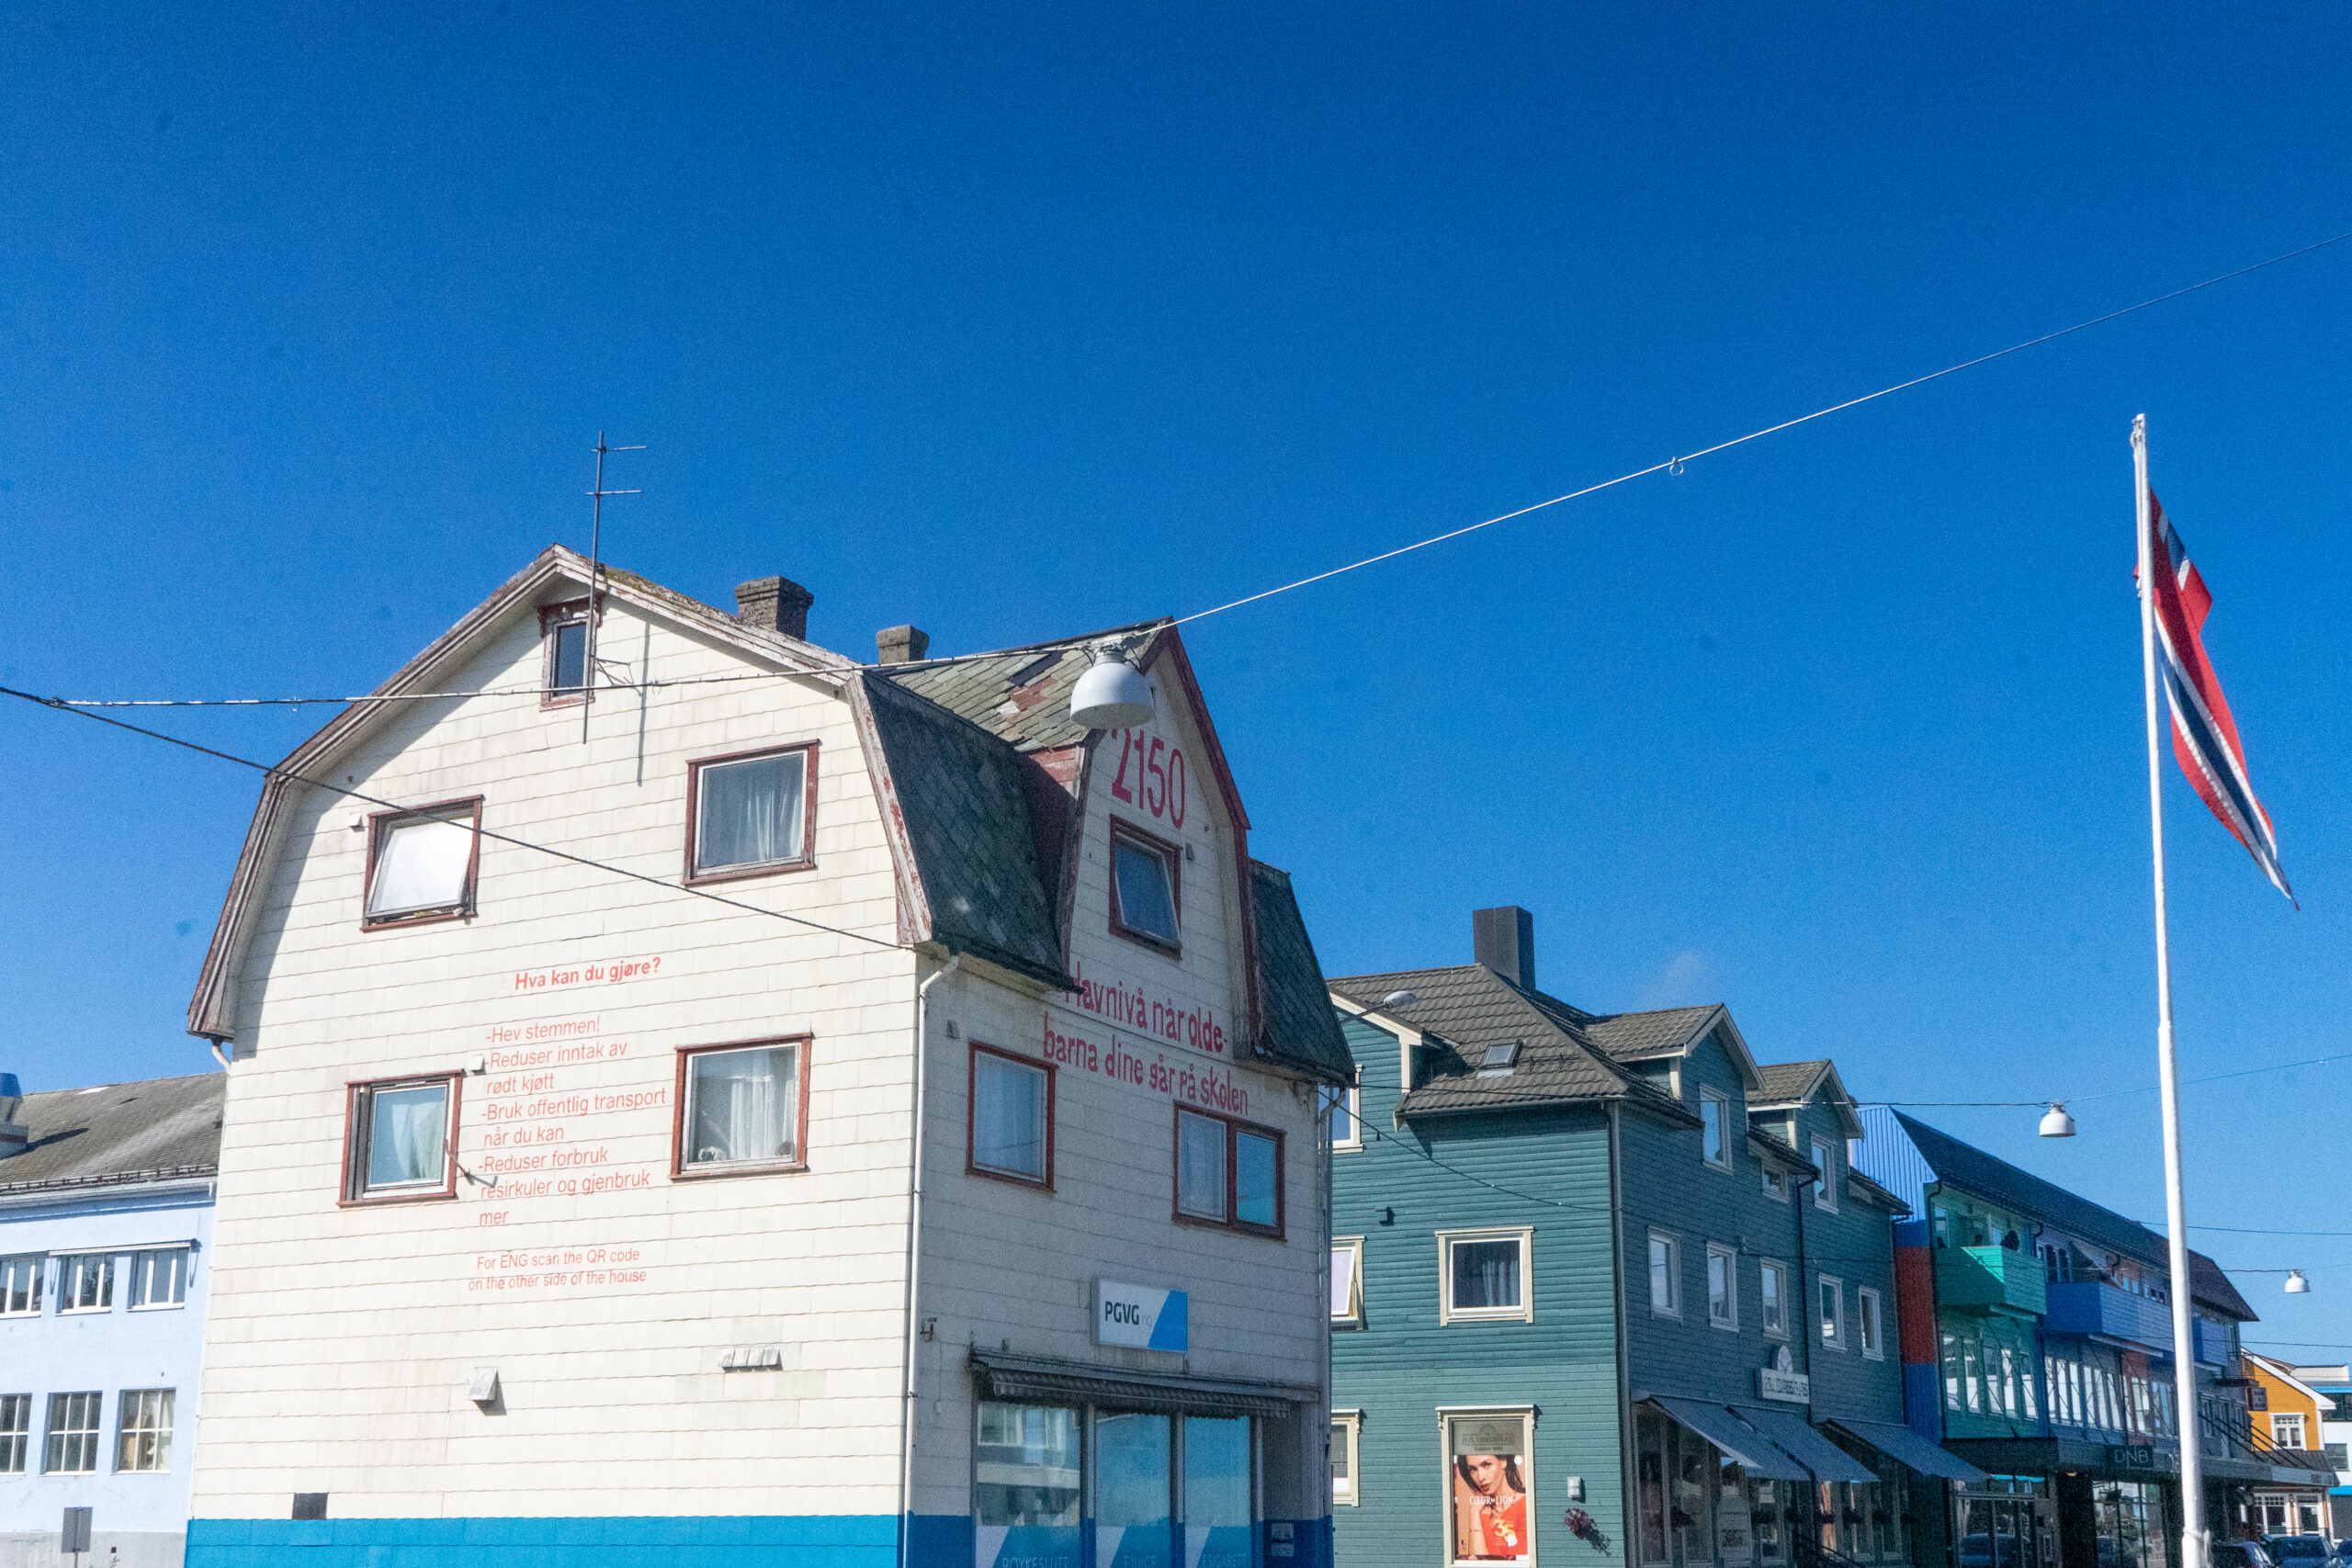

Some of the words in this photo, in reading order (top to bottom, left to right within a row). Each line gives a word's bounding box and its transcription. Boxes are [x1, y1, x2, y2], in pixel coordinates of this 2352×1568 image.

[1112, 728, 1185, 829] 2150
[515, 973, 545, 989] Hva
[551, 970, 579, 985] kan
[585, 966, 604, 981] du
[610, 957, 661, 982] gjøre?
[486, 1026, 520, 1043] -Hev
[526, 1016, 600, 1039] stemmen!
[1153, 999, 1185, 1041] når
[1189, 1007, 1227, 1053] olde-
[485, 1051, 552, 1068] -Reduser
[559, 1043, 603, 1061] inntak
[610, 1043, 627, 1056] av
[1043, 1010, 1098, 1073] barna
[1105, 1034, 1143, 1085] dine
[1149, 1055, 1175, 1094] går
[1180, 1064, 1196, 1100] på
[1200, 1066, 1249, 1115] skolen
[487, 1075, 516, 1094] rødt
[523, 1073, 553, 1095] kjøtt
[481, 1102, 522, 1121] -Bruk
[527, 1097, 588, 1116] offentlig
[595, 1088, 665, 1110] transport
[484, 1126, 508, 1146] når
[514, 1128, 531, 1144] du
[537, 1126, 563, 1141] kan
[478, 1156, 546, 1171] -Reduser
[552, 1146, 608, 1167] forbruk
[481, 1181, 551, 1199] resirkuler
[558, 1179, 576, 1196] og
[582, 1169, 650, 1195] gjenbruk
[480, 1211, 509, 1226] mer
[478, 1257, 496, 1269] For
[501, 1254, 527, 1268] ENG
[532, 1256, 559, 1266] scan
[564, 1253, 582, 1264] the
[588, 1249, 606, 1262] QR
[610, 1249, 639, 1262] code
[469, 1280, 482, 1291] on
[487, 1277, 504, 1290] the
[509, 1275, 538, 1288] other
[544, 1273, 567, 1286] side
[571, 1271, 582, 1285] of
[587, 1271, 605, 1284] the
[610, 1270, 646, 1282] house
[2114, 1447, 2149, 1469] DNB
